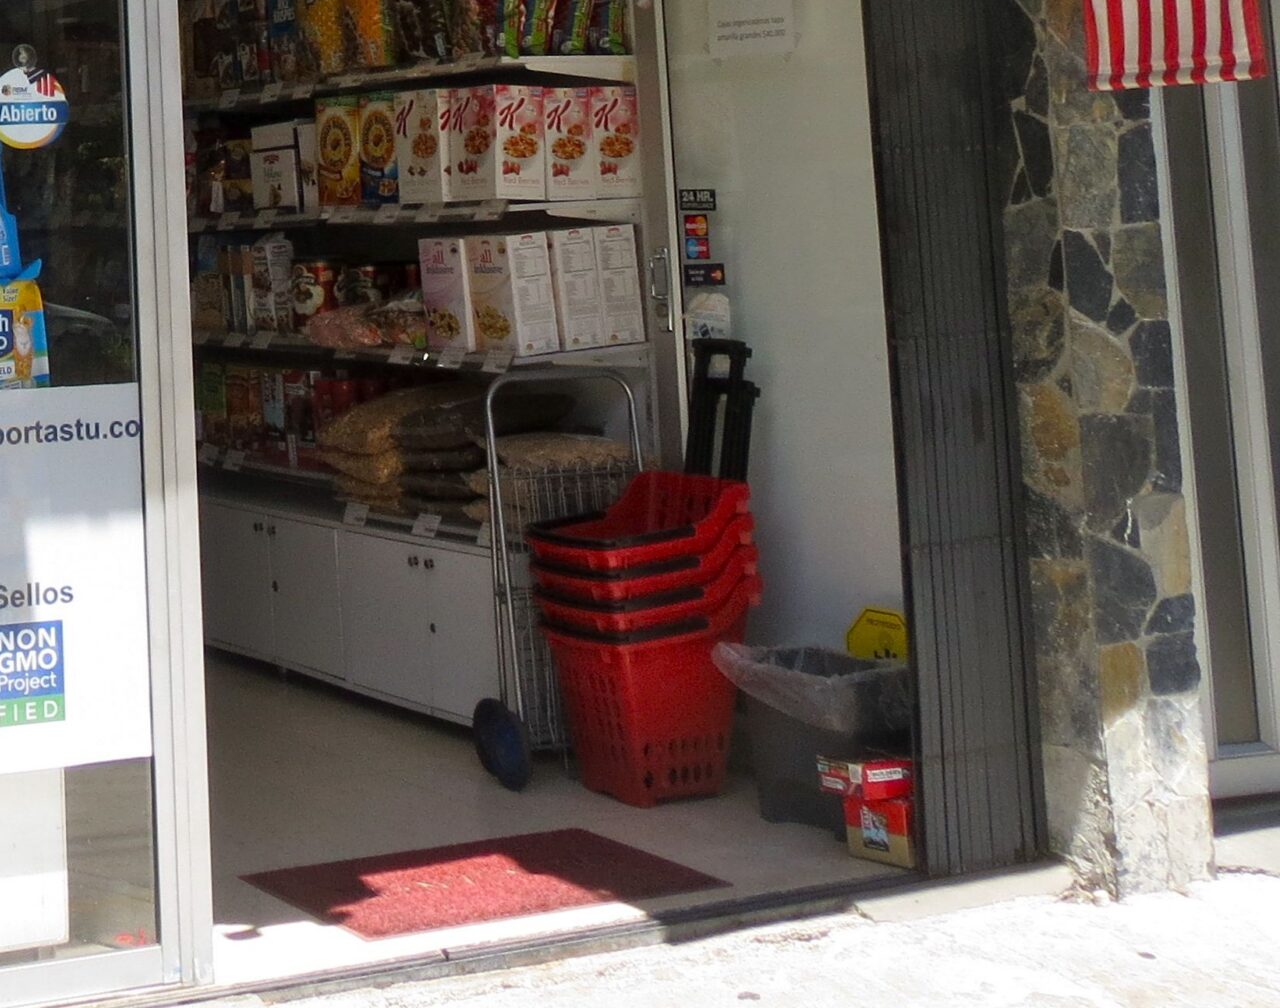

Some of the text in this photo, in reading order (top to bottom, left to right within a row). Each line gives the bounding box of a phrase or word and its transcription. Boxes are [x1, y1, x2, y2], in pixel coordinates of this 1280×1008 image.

[0, 104, 58, 123] Abierto
[499, 97, 525, 131] K
[546, 99, 572, 133] K
[593, 98, 619, 132] K
[682, 192, 694, 202] 24
